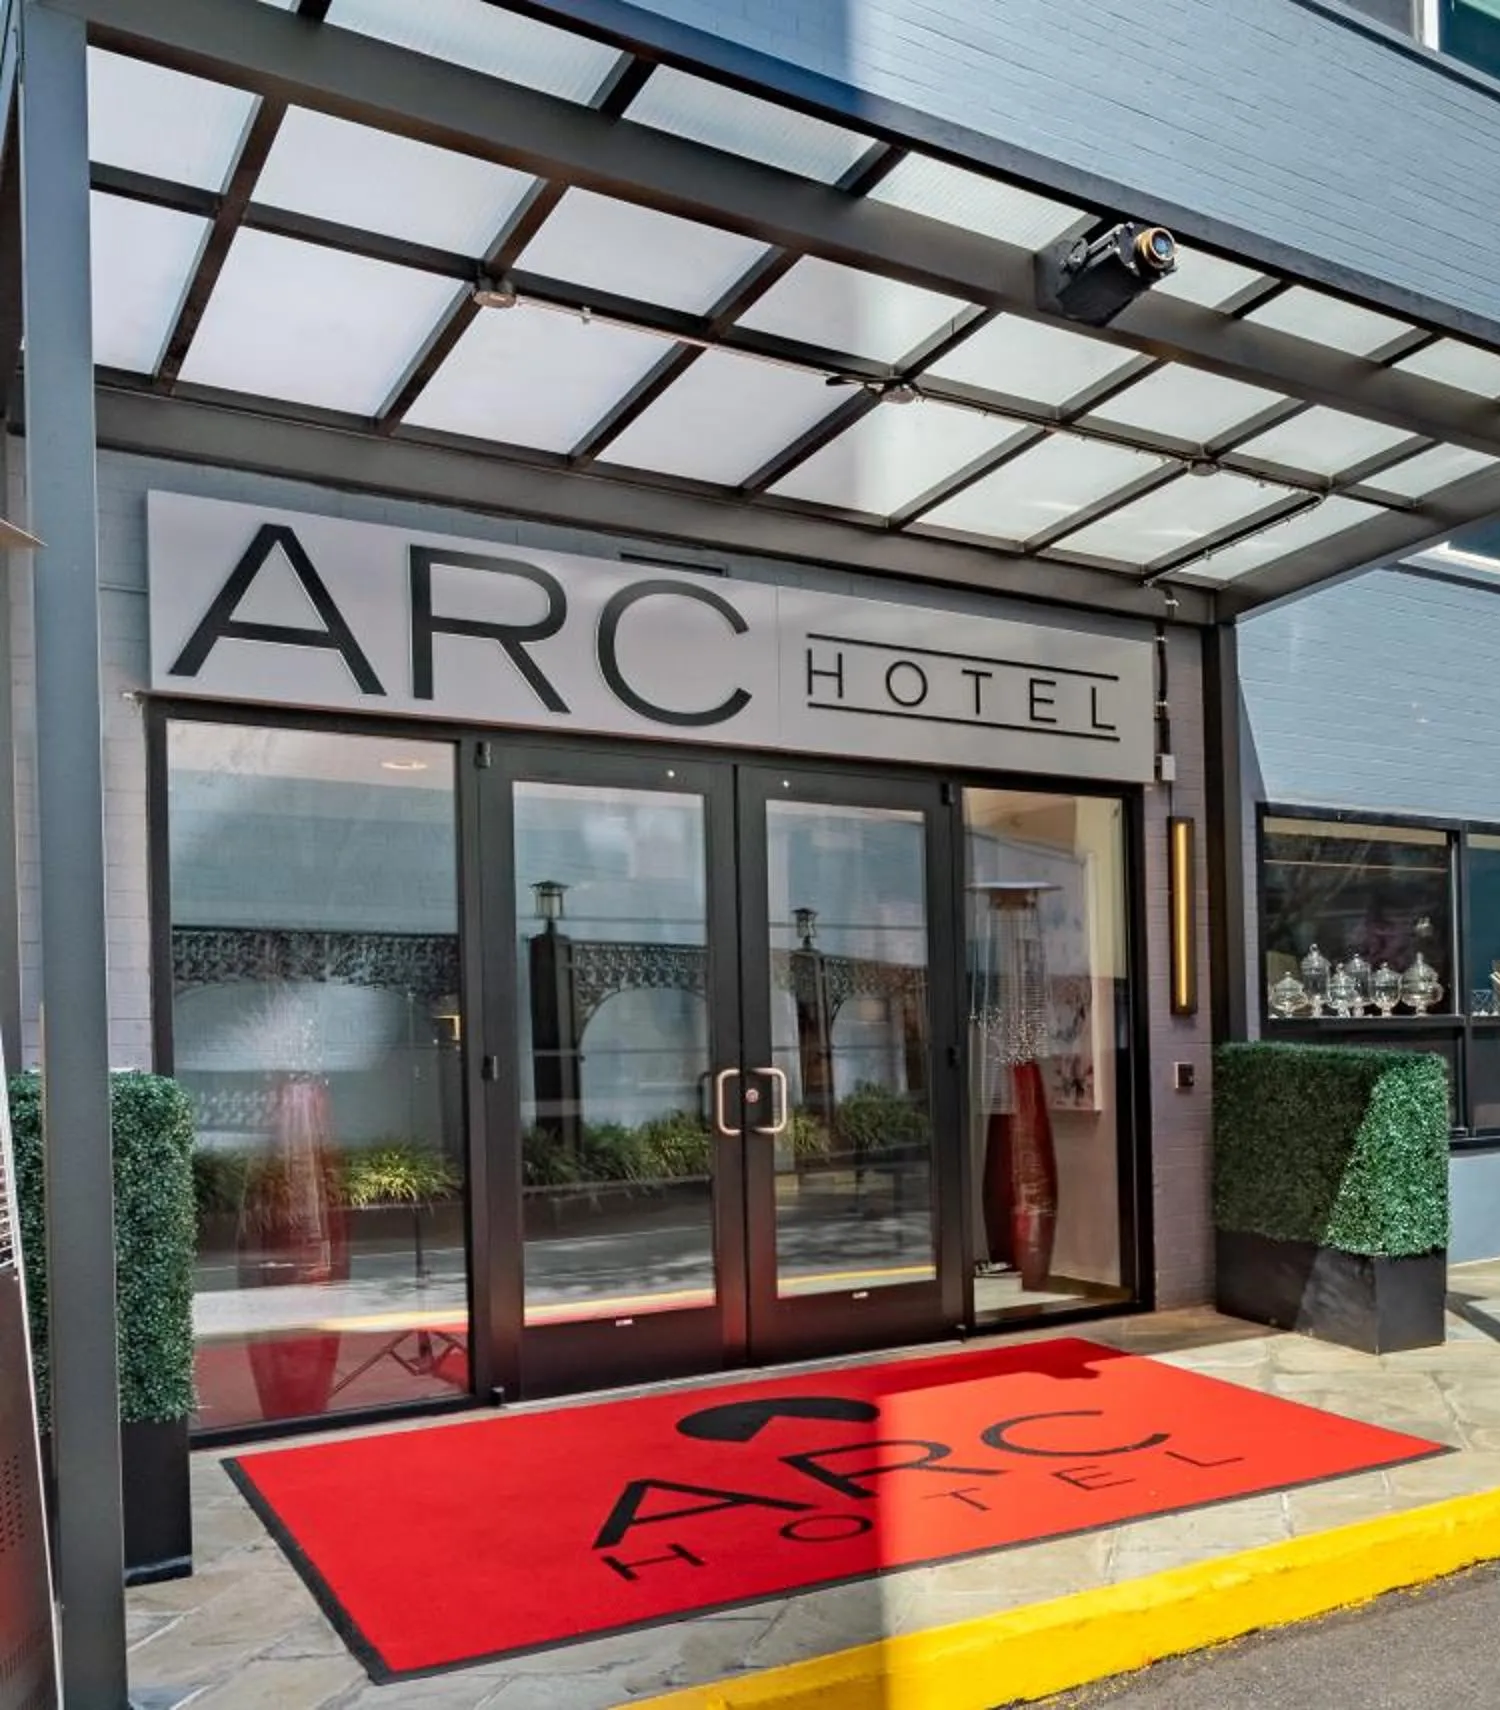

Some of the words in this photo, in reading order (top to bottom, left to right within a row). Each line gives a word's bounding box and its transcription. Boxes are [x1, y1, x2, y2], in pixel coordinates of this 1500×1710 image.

[168, 522, 754, 727] ARC
[806, 648, 1117, 731] HOTEL
[592, 1410, 1171, 1550] ARC
[602, 1450, 1245, 1581] HOTEL
